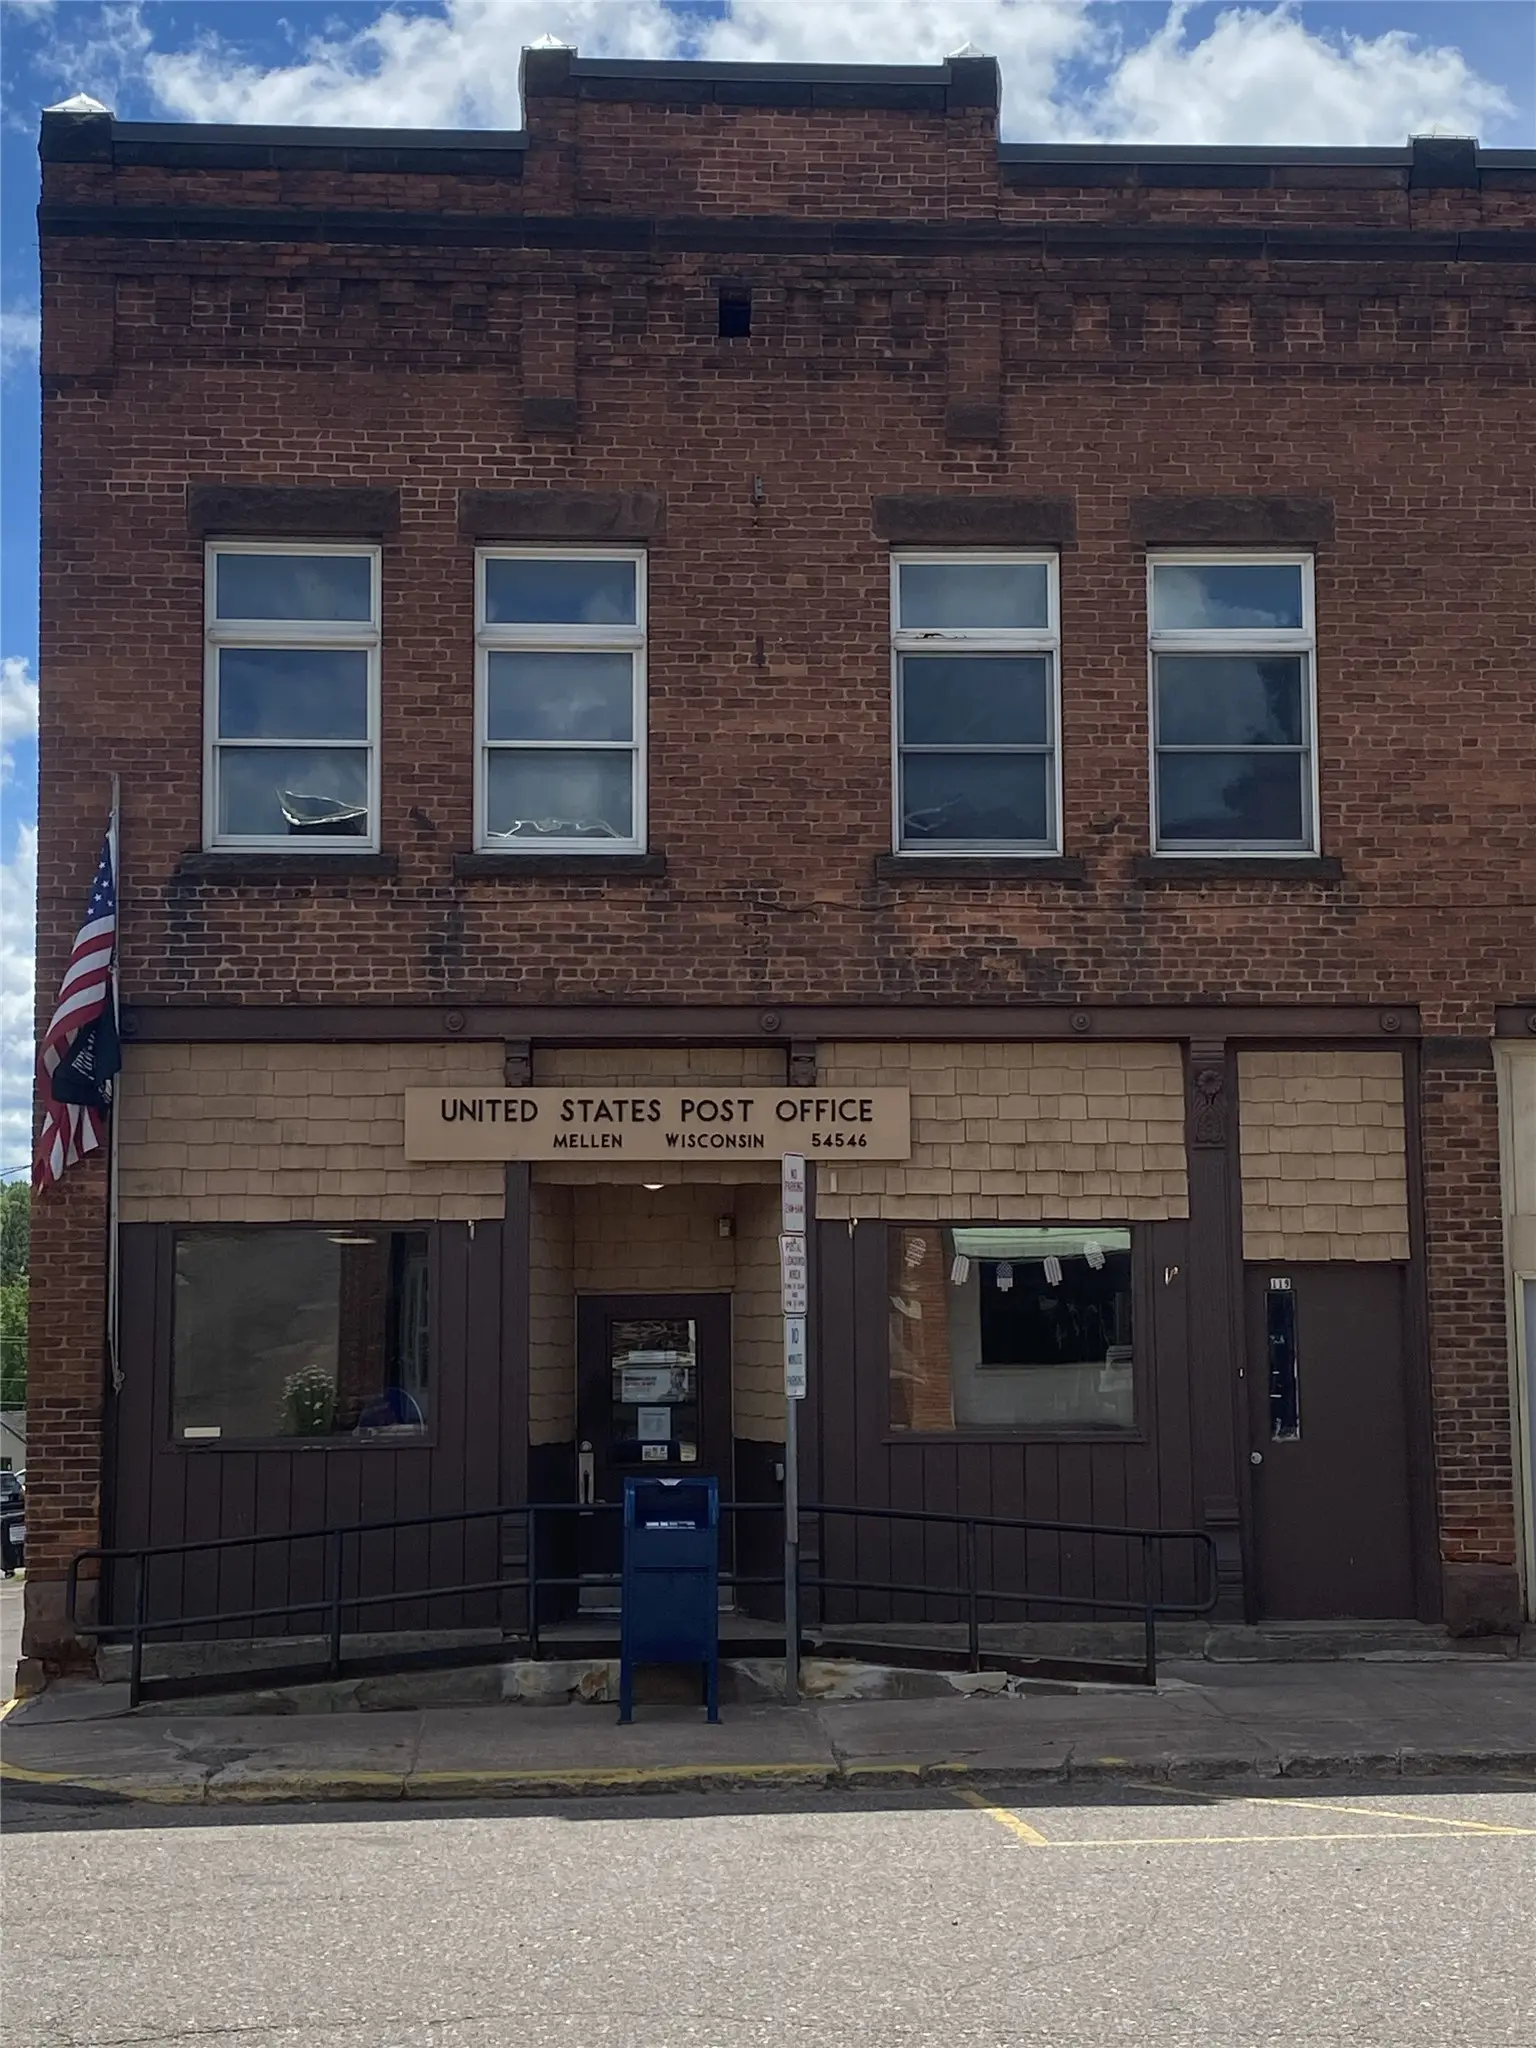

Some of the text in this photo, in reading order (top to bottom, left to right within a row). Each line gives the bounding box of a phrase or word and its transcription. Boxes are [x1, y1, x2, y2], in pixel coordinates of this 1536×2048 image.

[441, 1098, 874, 1123] UNITED STATES POST OFFICE
[553, 1132, 868, 1149] MELLEN WISCONSIN 54546
[790, 1168, 798, 1180] NO
[784, 1181, 804, 1192] PARKING
[1272, 1279, 1290, 1289] 119
